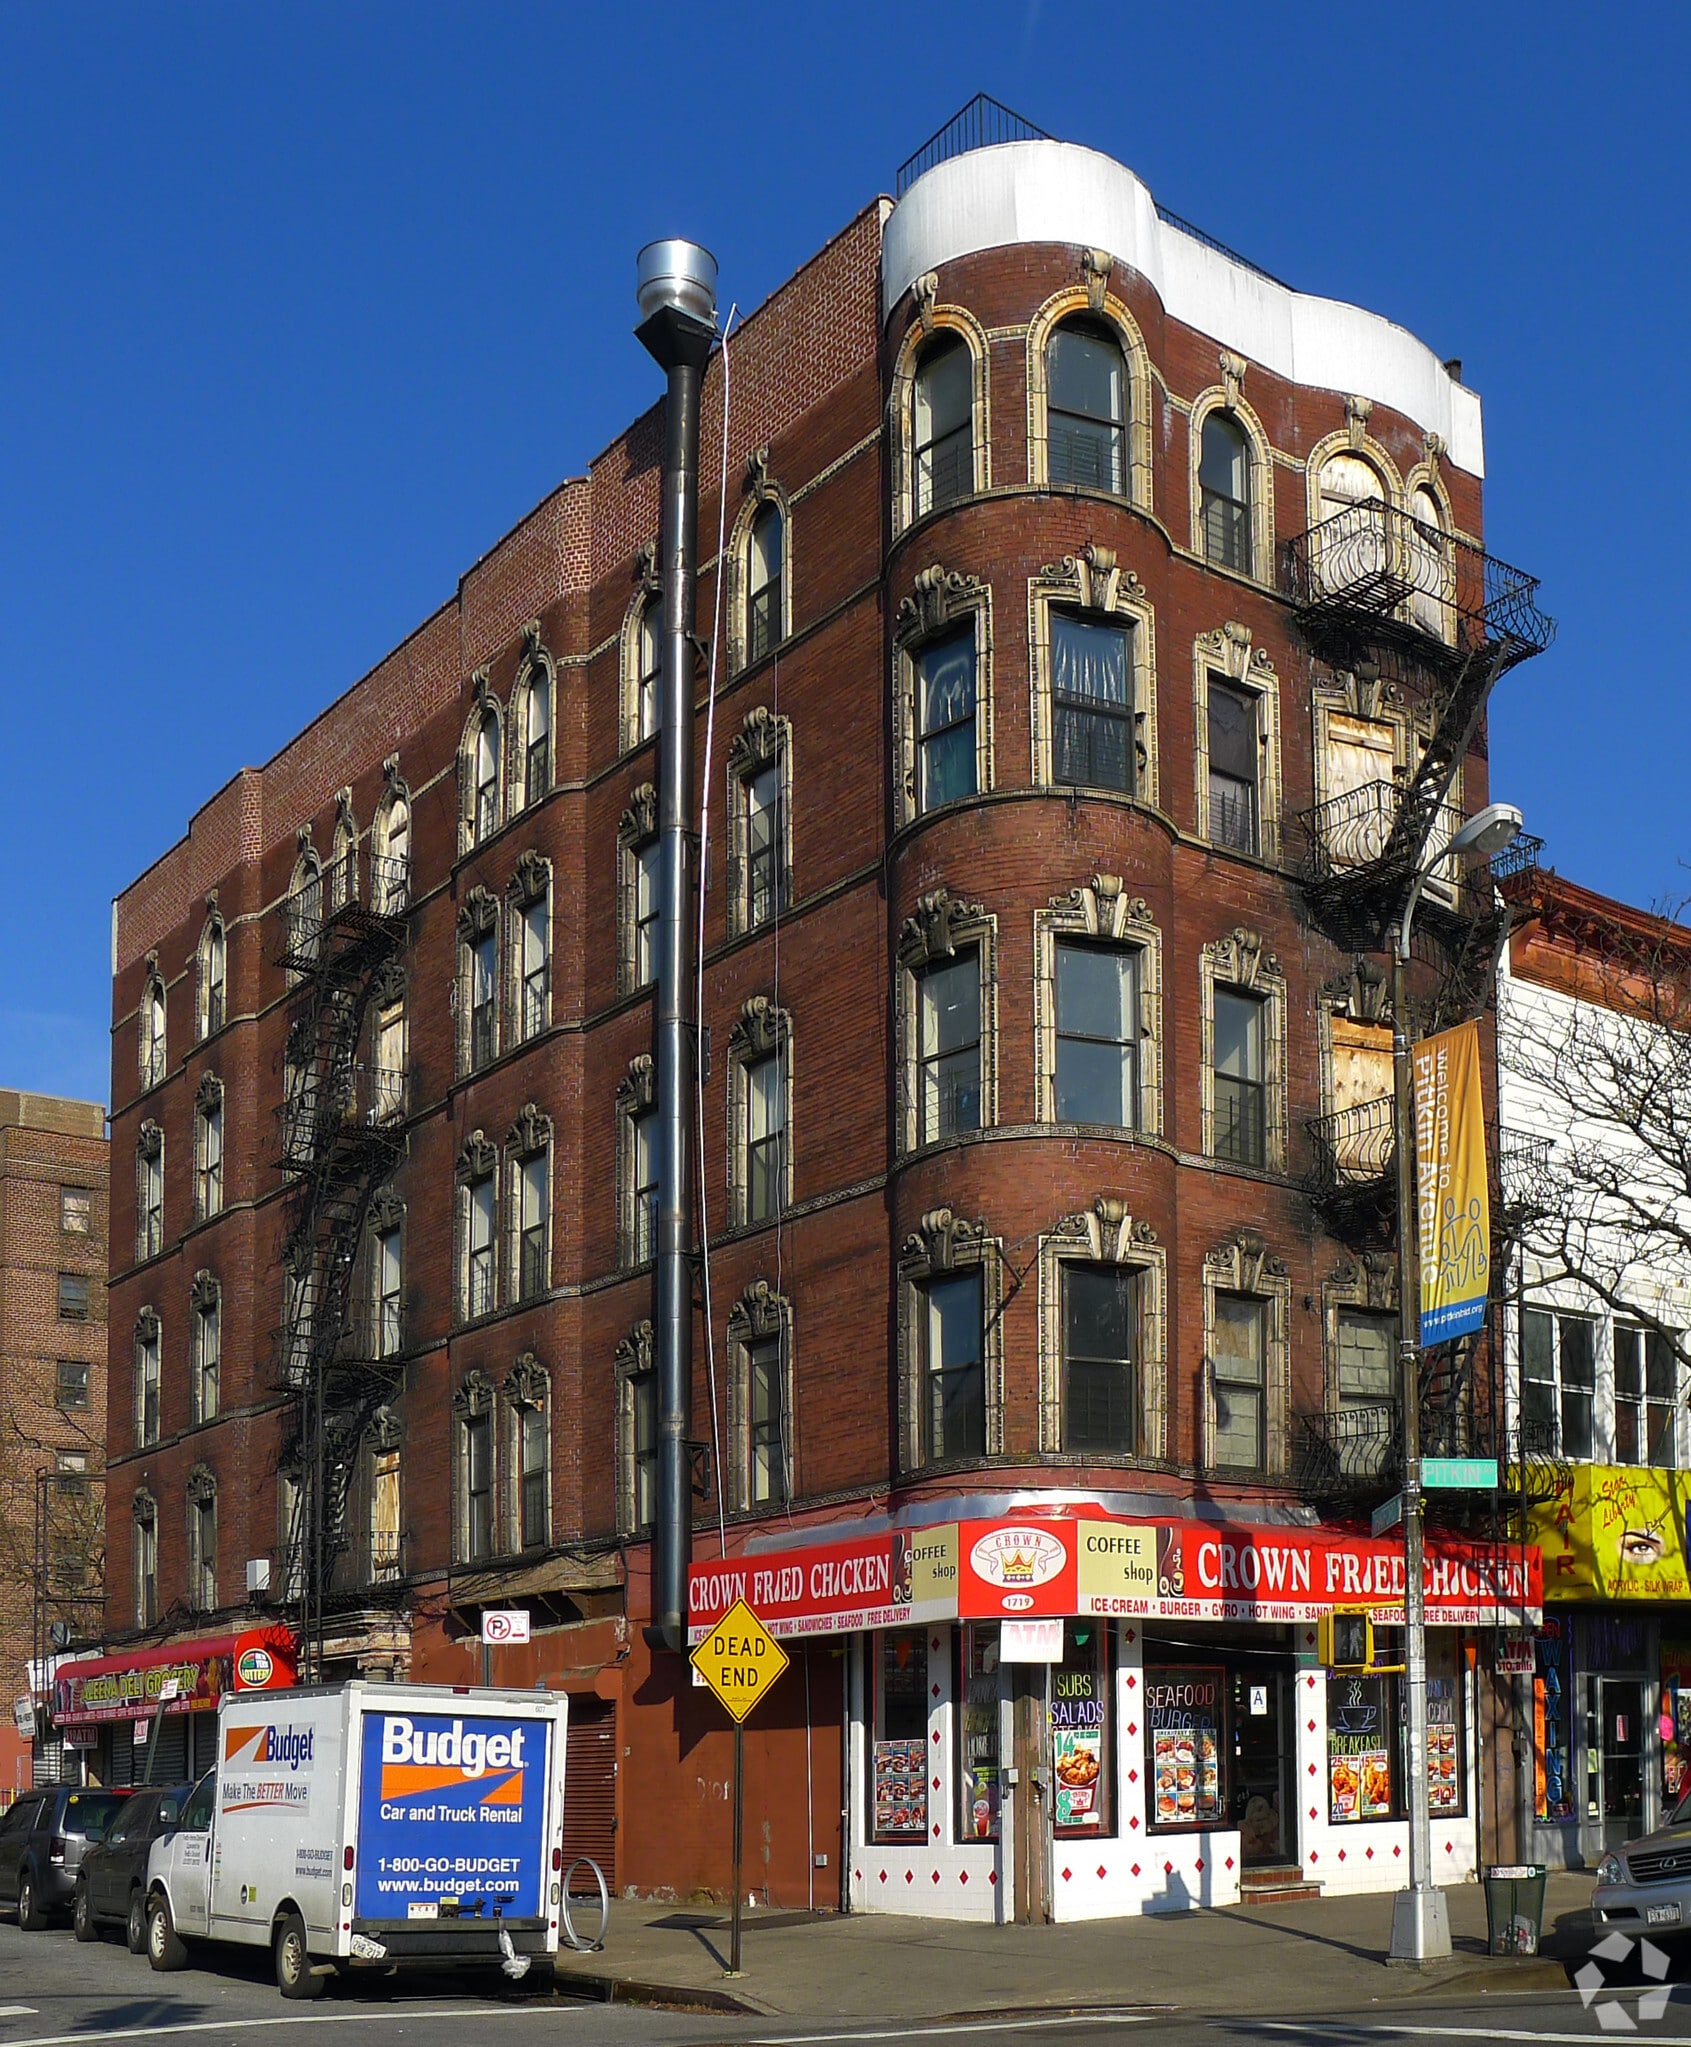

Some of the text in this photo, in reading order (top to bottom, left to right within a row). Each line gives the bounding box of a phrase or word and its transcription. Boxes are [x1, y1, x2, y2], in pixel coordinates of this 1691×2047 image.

[1436, 1048, 1451, 1189] welcome to
[1418, 1162, 1438, 1284] Avenue
[1424, 1463, 1480, 1484] PITKIN
[995, 1533, 1043, 1549] CROWN
[1086, 1535, 1142, 1555] COFFEE
[932, 1561, 957, 1581] shop
[1123, 1560, 1154, 1587] shop
[1197, 1541, 1311, 1593] CROWN
[1325, 1552, 1406, 1596] FRIED
[688, 1553, 890, 1613] CROWN FRIED CHICKEN
[1607, 1580, 1683, 1592] ACRYLIC SILK WRAP
[1006, 1597, 1031, 1608] 1719
[1090, 1597, 1149, 1614] ICE-CREAM
[1159, 1600, 1201, 1616] BURGER
[1211, 1602, 1238, 1617] GYRO
[1248, 1604, 1268, 1618] HOT
[1271, 1604, 1295, 1619] WING
[1373, 1608, 1406, 1622] SEAFOO
[1424, 1609, 1441, 1622] REE
[1442, 1609, 1479, 1623] DELIVERY
[779, 1620, 793, 1635] WING
[797, 1616, 833, 1633] SANDWICHES
[837, 1613, 863, 1630] SEAFOOD
[867, 1610, 883, 1625] FREE
[883, 1607, 911, 1624] DELIVERY
[1009, 1624, 1059, 1646] ATM
[714, 1636, 766, 1657] DEAD
[119, 1674, 144, 1698] DELI
[721, 1667, 758, 1687] END
[1056, 1674, 1092, 1697] SUBS
[1145, 1684, 1215, 1708] SEAFOOD
[1253, 1690, 1263, 1706] A
[1051, 1700, 1105, 1725] SALADS
[1150, 1708, 1211, 1729] BURGER
[1541, 1641, 1562, 1802] WAXING
[267, 1724, 314, 1771] Budget
[382, 1716, 525, 1778] Budget
[1055, 1731, 1075, 1758] 14
[1331, 1756, 1343, 1768] 25
[1361, 1756, 1370, 1768] 15
[222, 1782, 308, 1800] Make The BETTER Move
[380, 1803, 523, 1823] Car and Truck Rental
[1057, 1789, 1072, 1821] 8
[1332, 1803, 1344, 1815] 20
[295, 1865, 333, 1879] www.budget.com
[377, 1857, 521, 1873] 1-800-GO-BUDGET
[377, 1878, 520, 1895] www.budget.com
